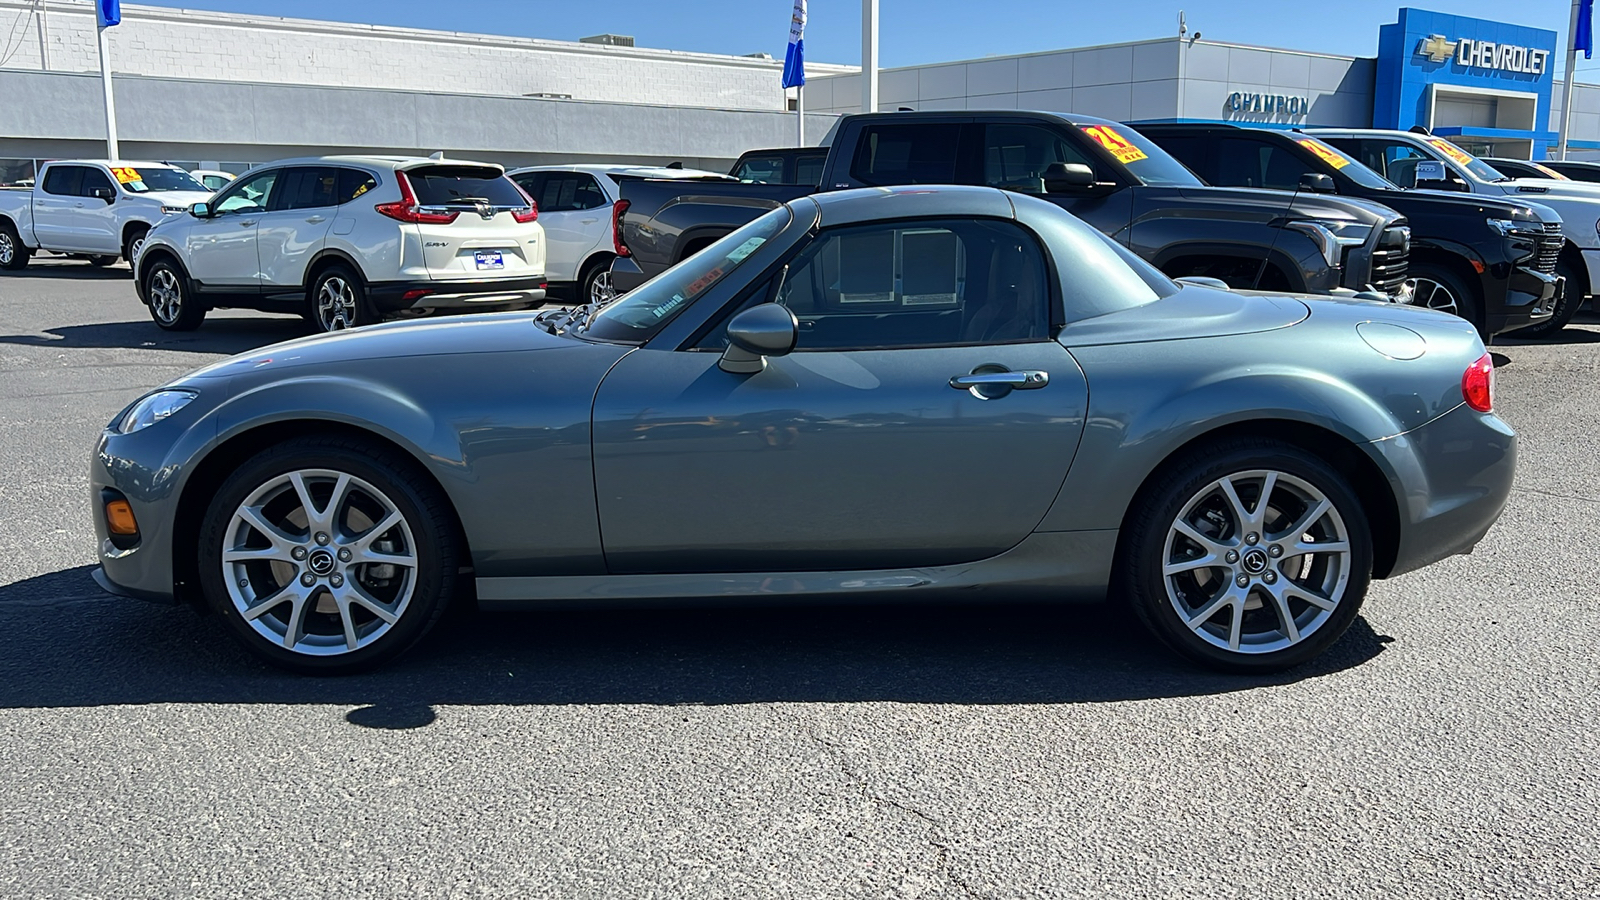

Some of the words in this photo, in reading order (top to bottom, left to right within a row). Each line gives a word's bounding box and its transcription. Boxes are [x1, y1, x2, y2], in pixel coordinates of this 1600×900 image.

[1457, 38, 1550, 75] CHEVROLET
[1230, 92, 1308, 115] CHAMPION
[1086, 126, 1132, 150] 24
